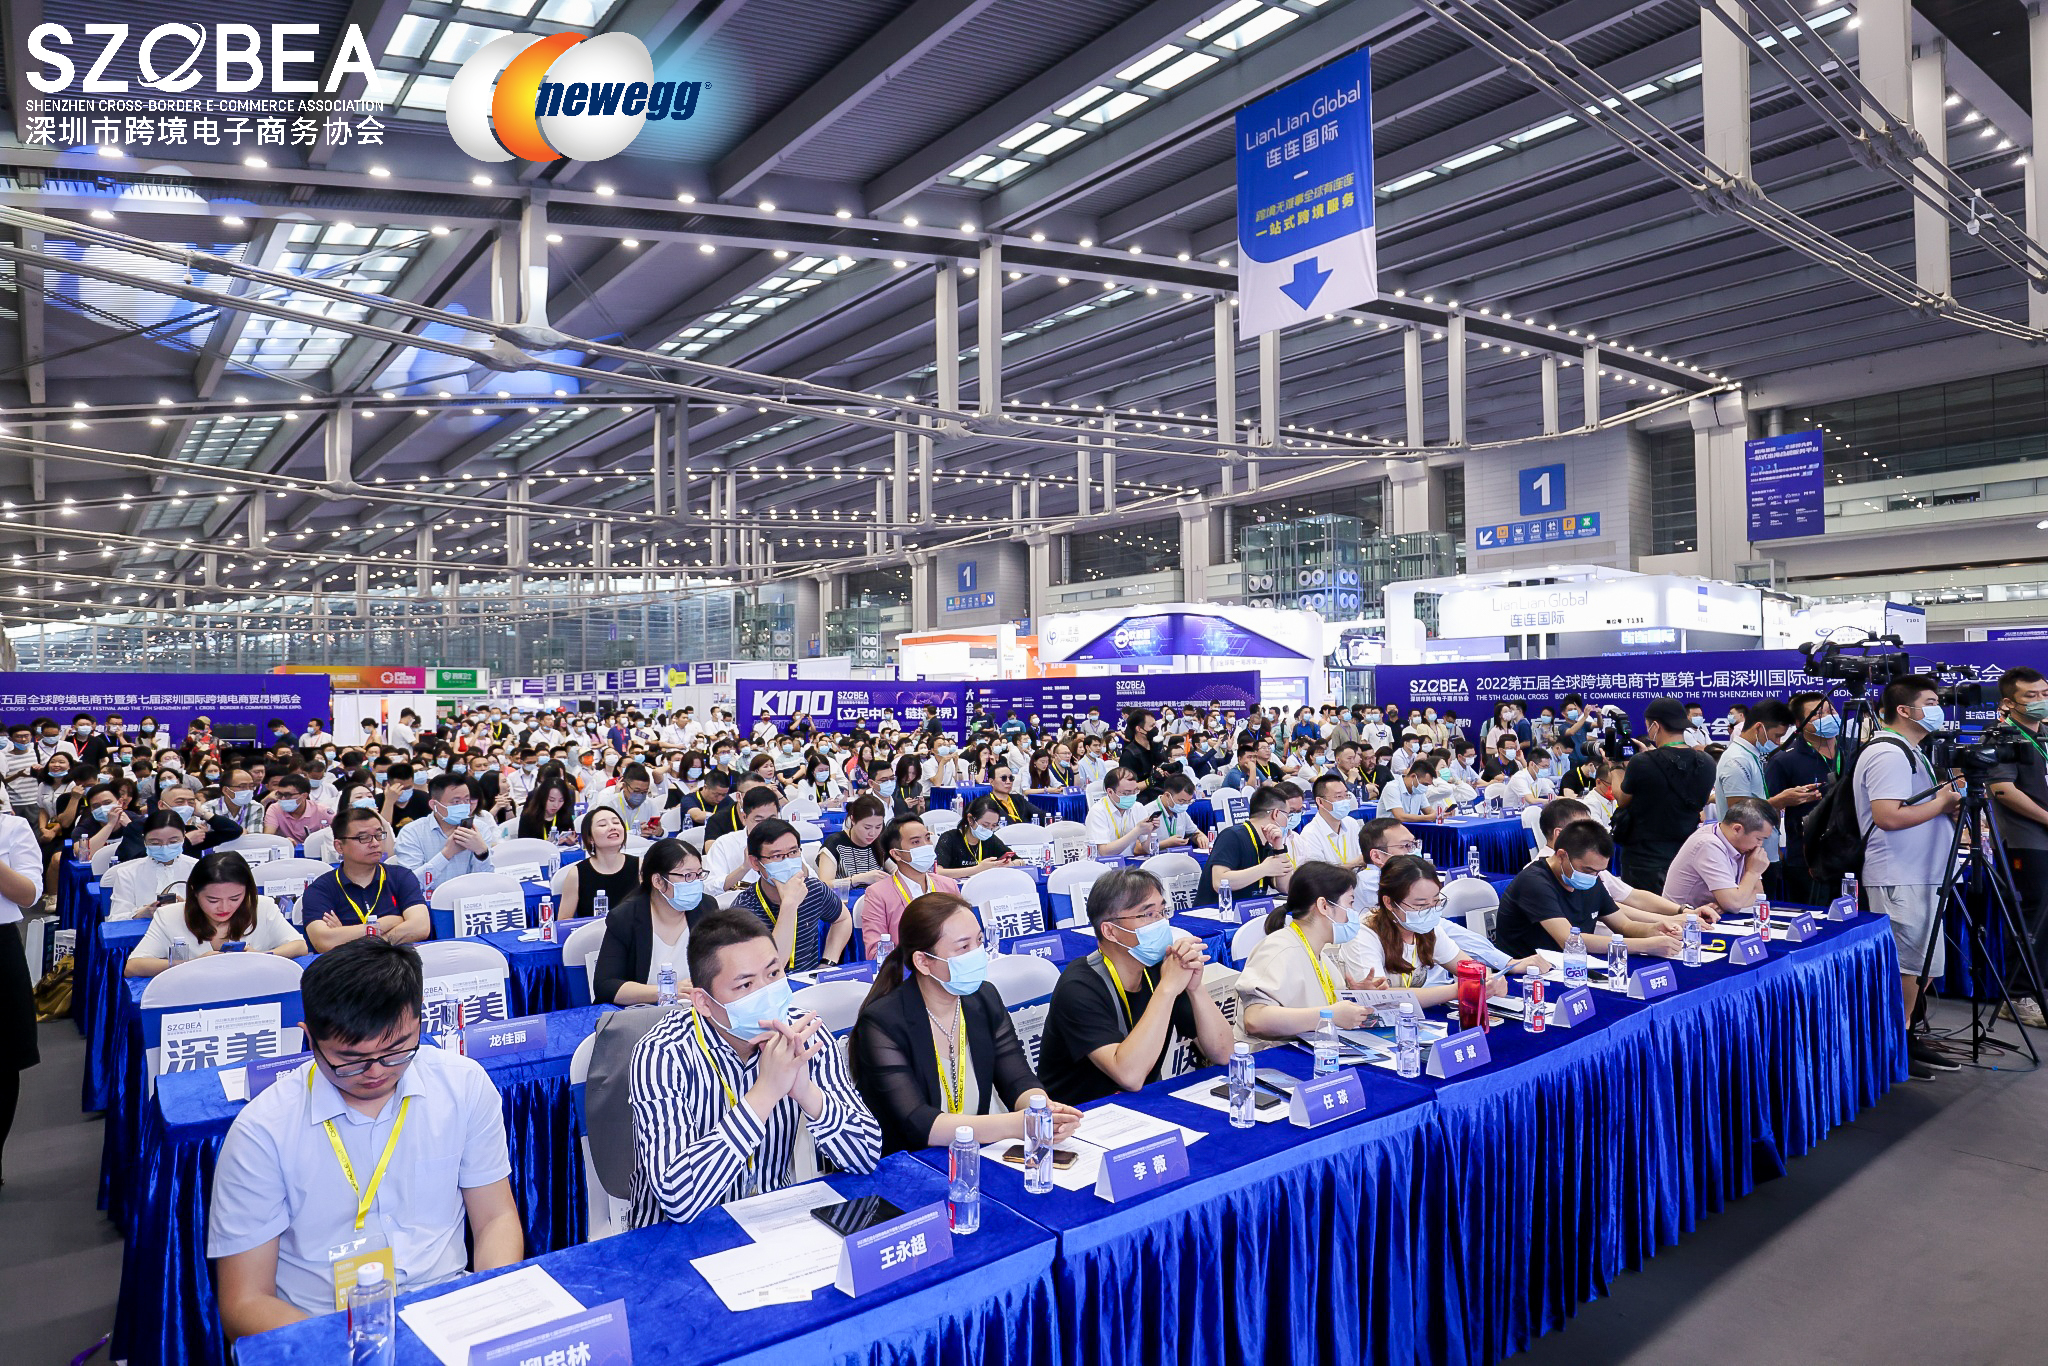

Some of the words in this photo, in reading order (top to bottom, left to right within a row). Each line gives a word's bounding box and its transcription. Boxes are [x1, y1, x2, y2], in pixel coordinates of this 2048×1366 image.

[1246, 109, 1310, 151] LianLian
[1312, 80, 1361, 120] Global
[1266, 119, 1339, 169] 连连国际
[1255, 191, 1354, 237] 一站式跨境服务
[1533, 472, 1551, 506] 1
[963, 566, 971, 587] 1
[1548, 590, 1588, 607] Global
[1510, 610, 1565, 628] 连连国际
[0, 694, 302, 705] 五届全球跨境电商节暨第七届深圳国际跨境电商贸易博览会
[752, 690, 834, 717] K100
[1502, 693, 1527, 701] GLOBAL
[1666, 691, 1684, 699] AND
[1685, 691, 1700, 699] THE
[1702, 691, 1718, 699] 7TH
[1719, 690, 1764, 698] SHENZHEN
[465, 907, 524, 936] 深美
[995, 909, 1044, 938] 深美
[167, 1028, 277, 1075] 深美
[488, 1030, 527, 1048] 龙佳丽
[880, 1232, 928, 1270] 王永超
